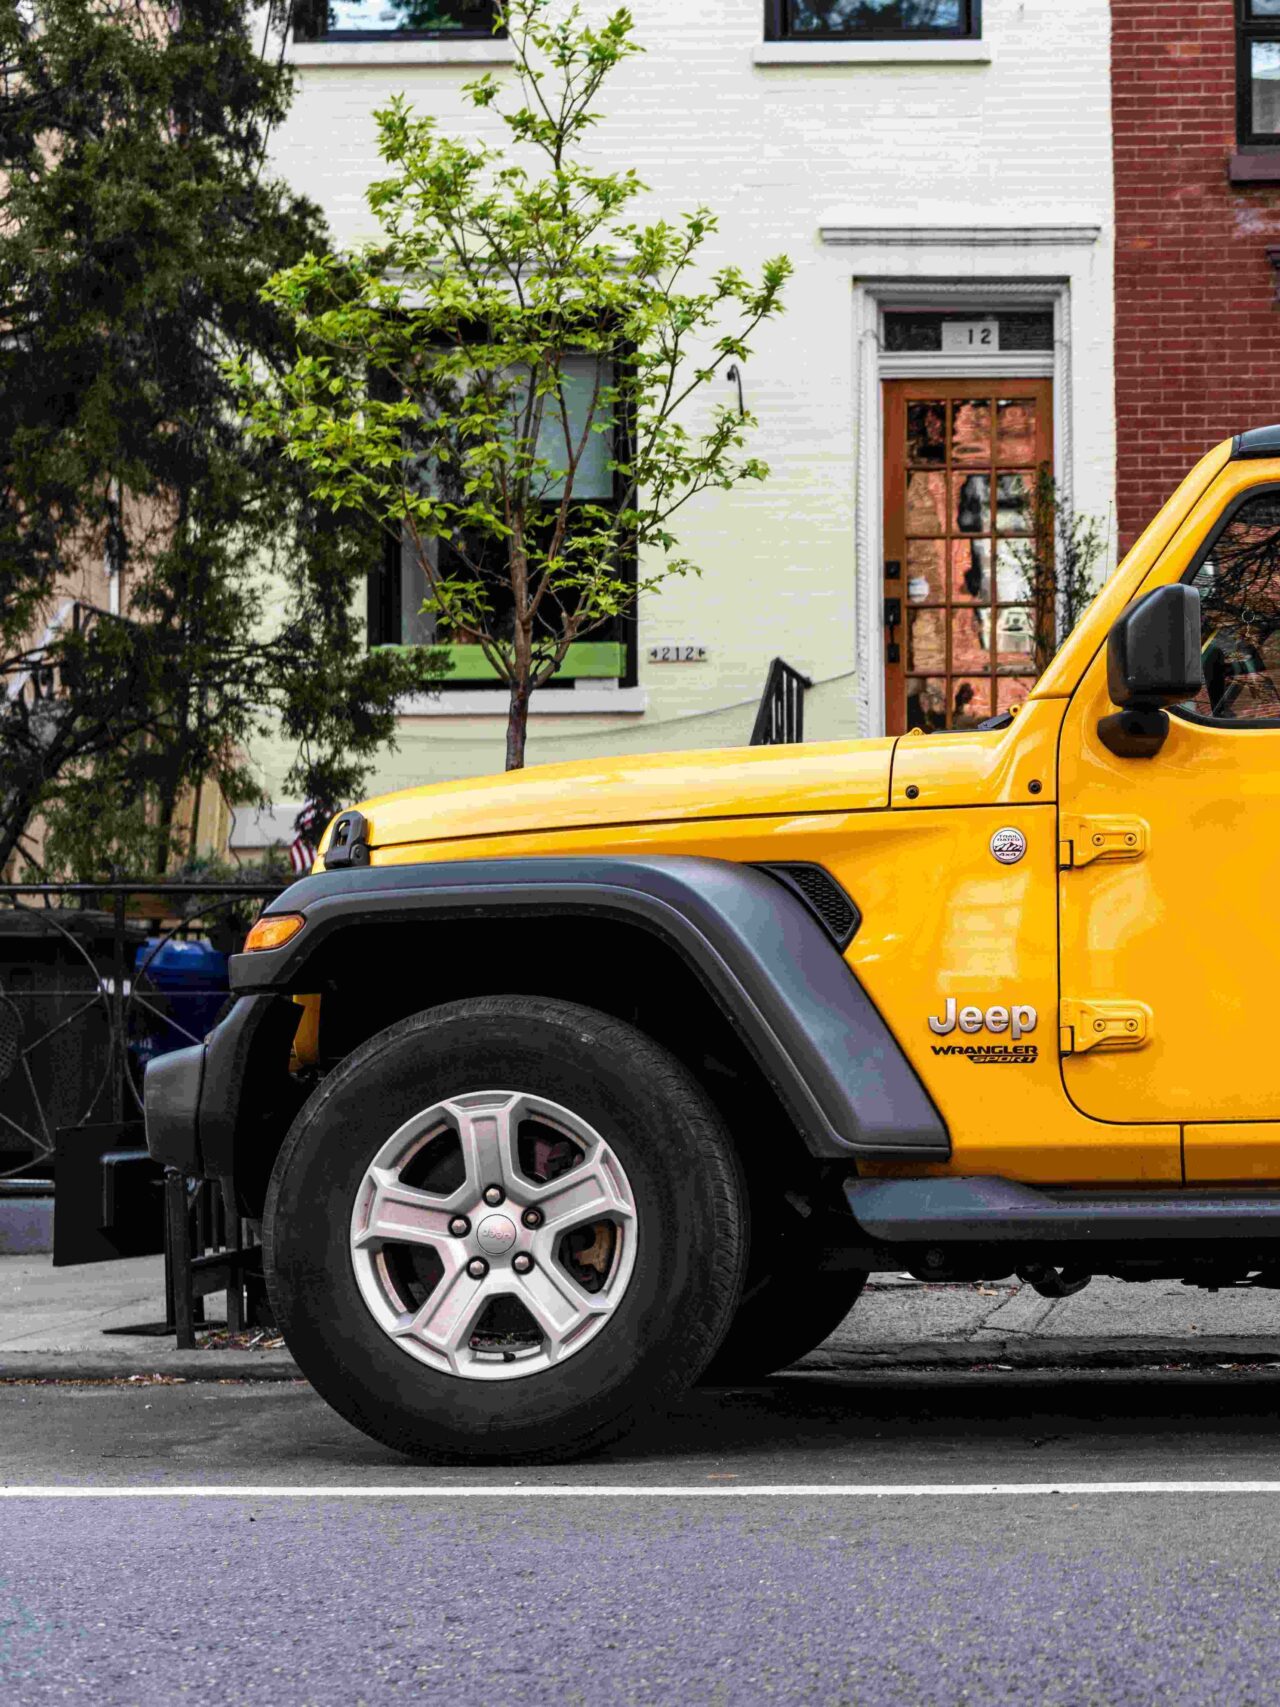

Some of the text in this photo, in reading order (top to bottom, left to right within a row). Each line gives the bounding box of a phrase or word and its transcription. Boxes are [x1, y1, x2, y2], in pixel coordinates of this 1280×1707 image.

[662, 646, 694, 660] 212
[928, 997, 1038, 1040] Jeep
[930, 1045, 1038, 1055] WRANGLER
[972, 1055, 1035, 1063] SPORT
